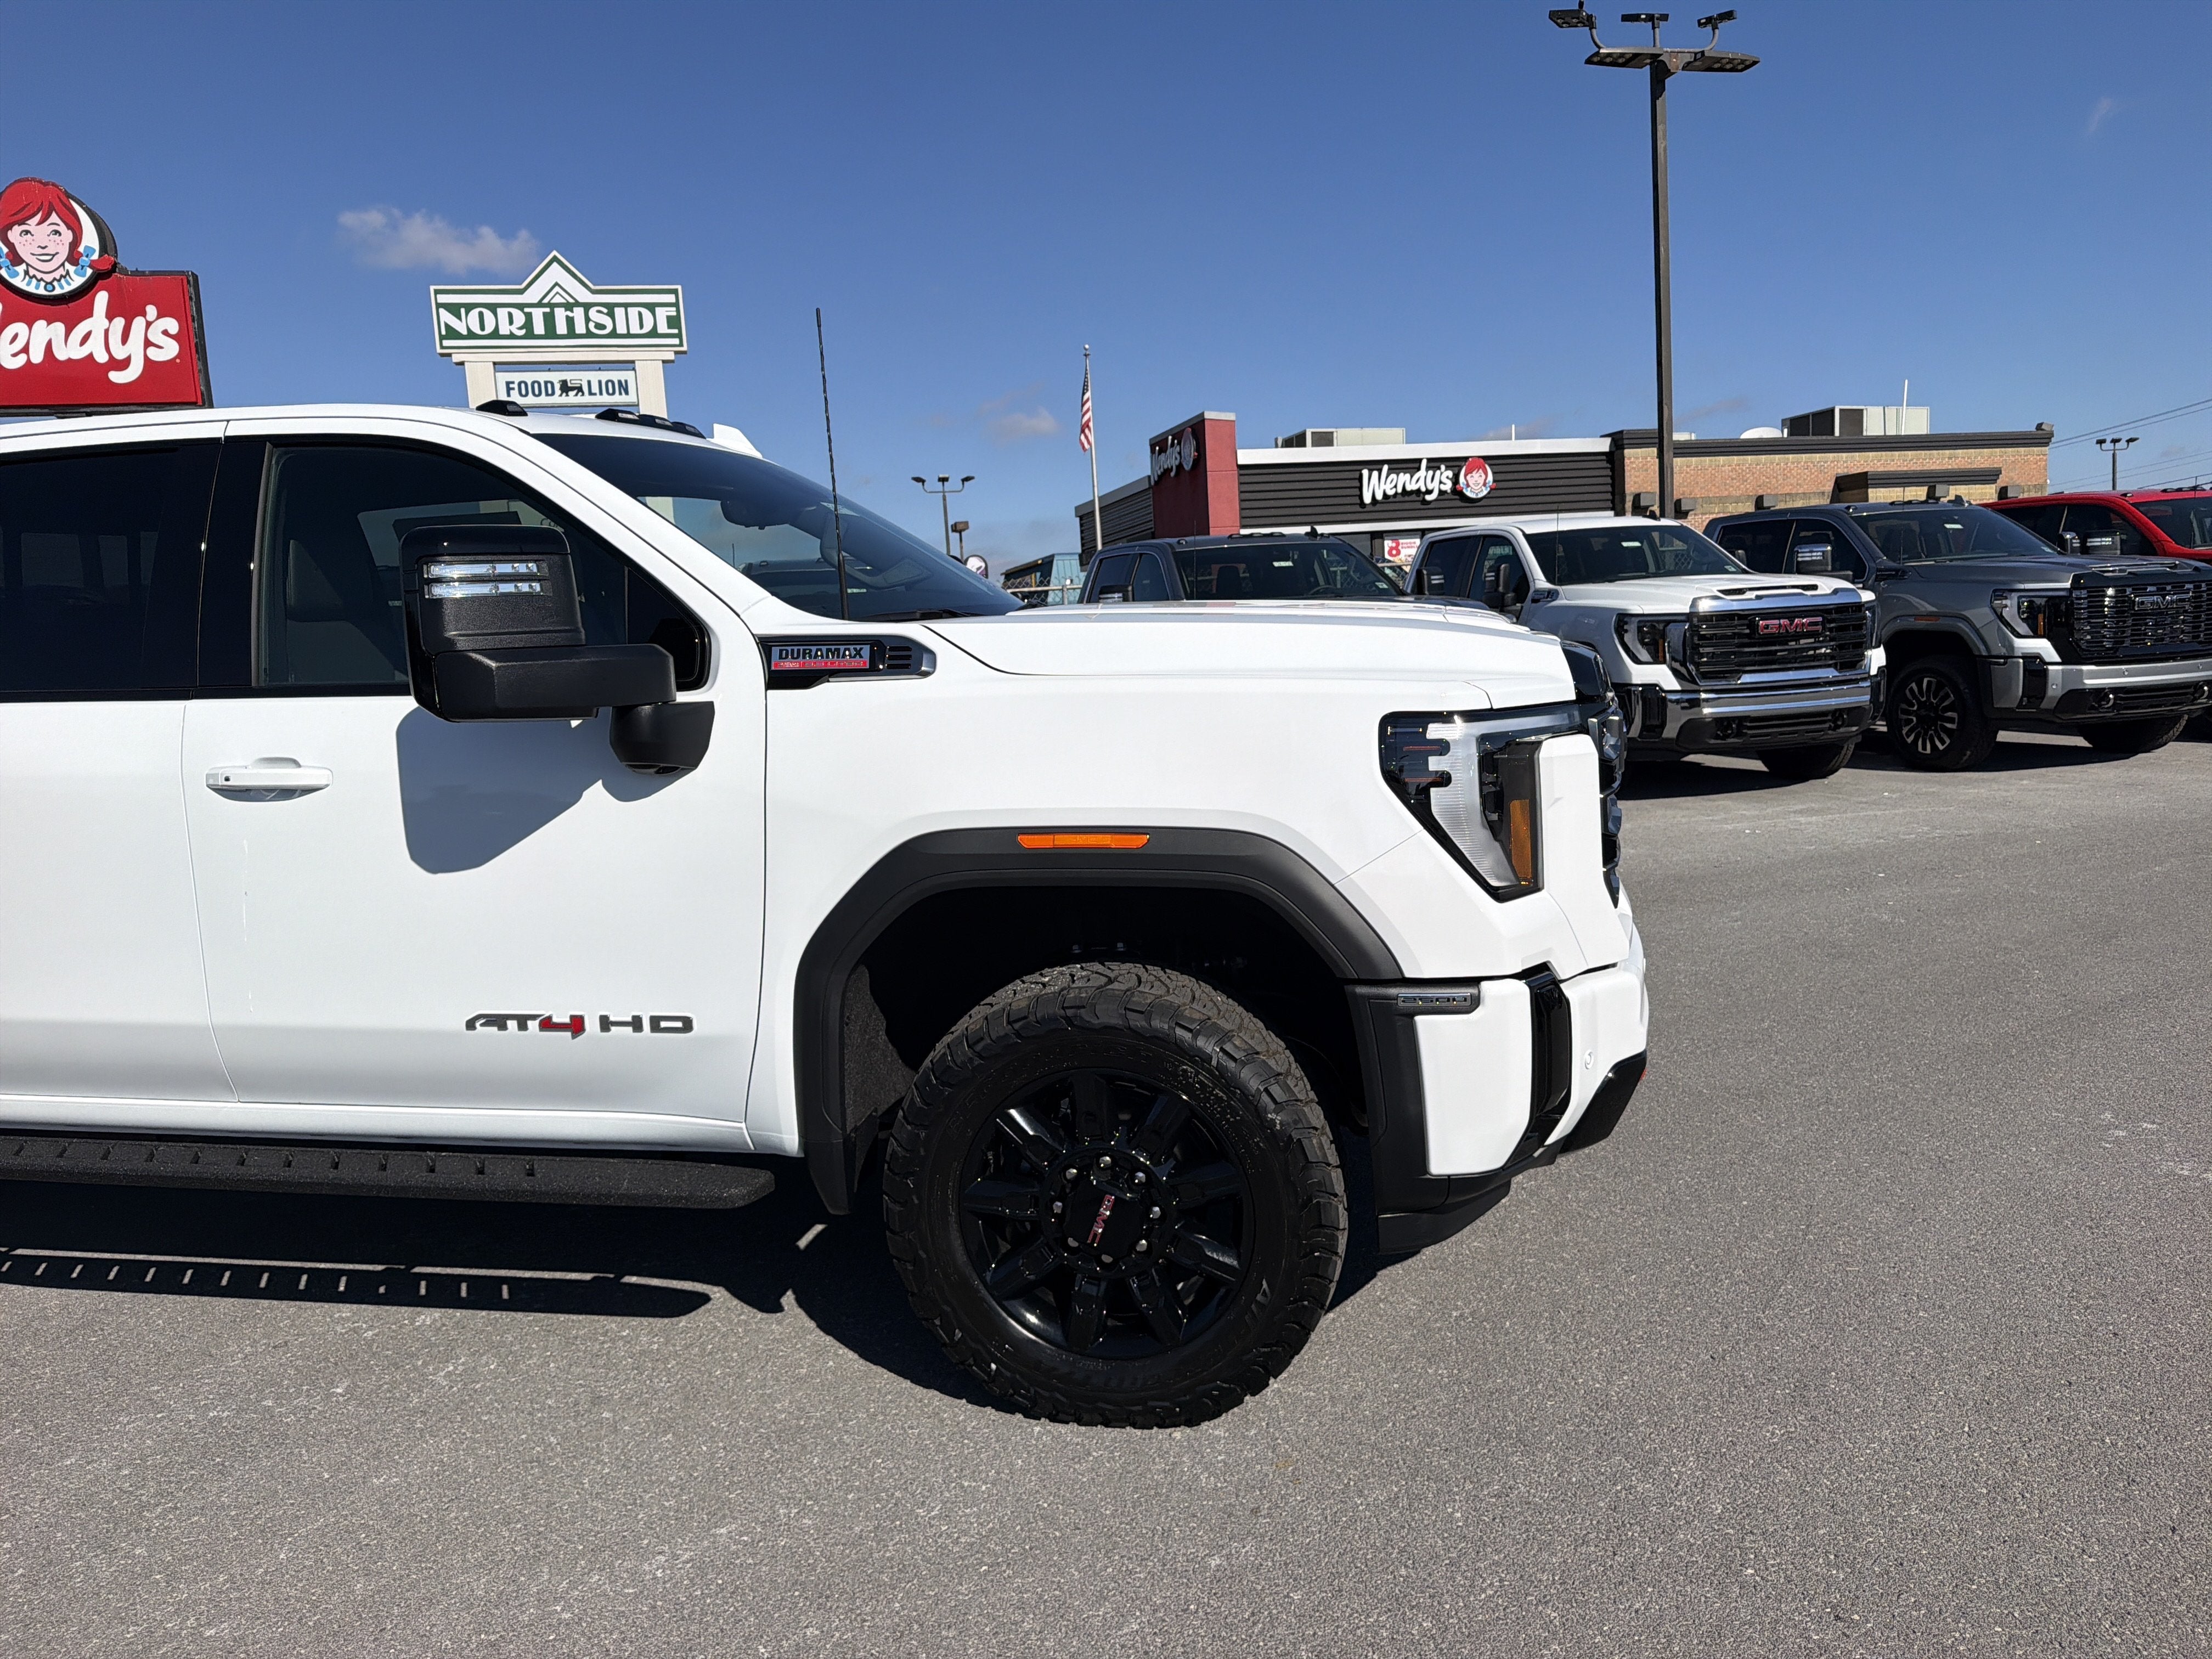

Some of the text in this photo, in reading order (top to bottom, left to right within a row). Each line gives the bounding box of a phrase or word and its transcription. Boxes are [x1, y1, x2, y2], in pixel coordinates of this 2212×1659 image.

[439, 306, 679, 336] NORTHSIDE
[0, 290, 179, 383] endy's
[505, 379, 630, 398] FOOD LION
[1362, 458, 1453, 504] Wendy's
[2135, 594, 2191, 610] GMC
[1759, 617, 1822, 635] GMC
[778, 647, 864, 661] DURAMAX
[465, 1013, 694, 1040] AT4 HD
[1086, 1194, 1115, 1246] GMC
